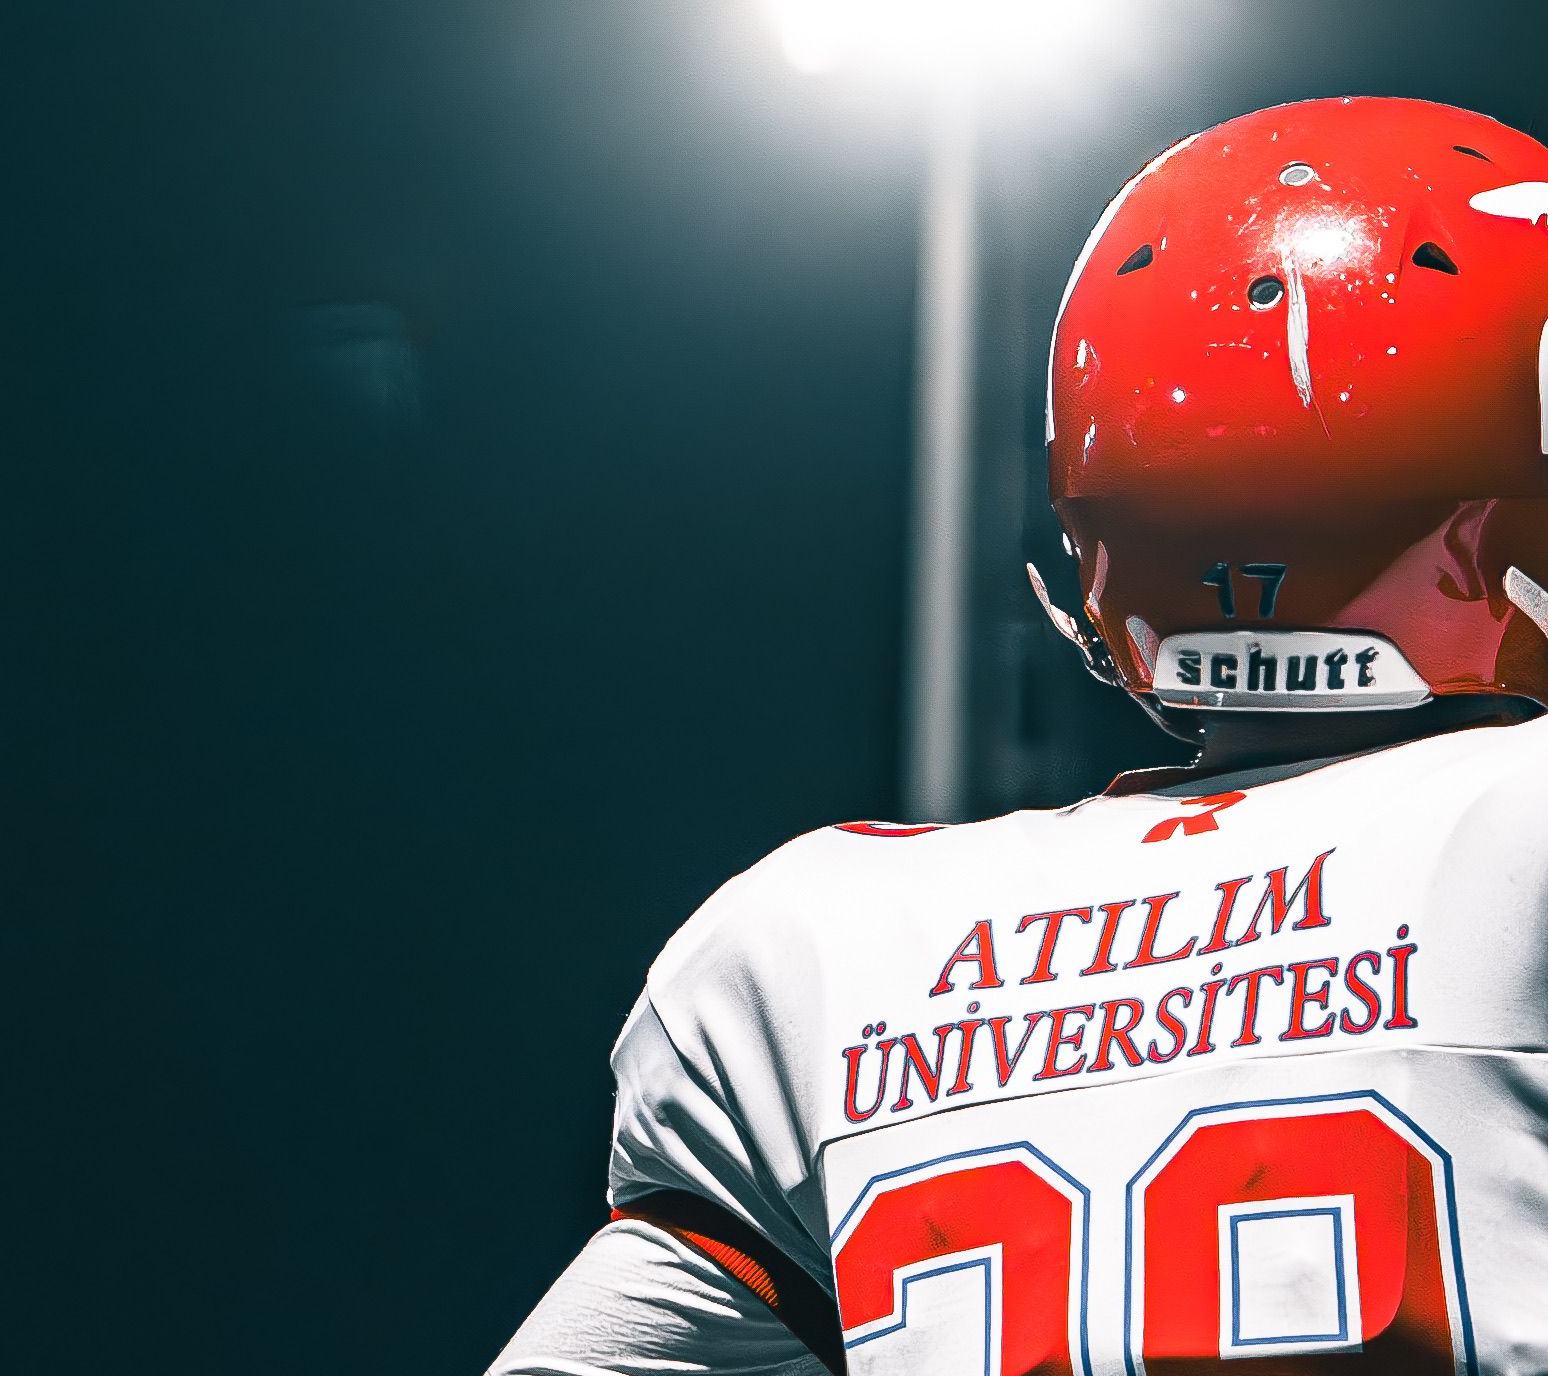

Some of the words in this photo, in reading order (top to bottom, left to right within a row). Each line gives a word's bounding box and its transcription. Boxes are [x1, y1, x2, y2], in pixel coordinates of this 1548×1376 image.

[1203, 561, 1288, 619] 17
[1175, 640, 1380, 692] schutt
[929, 847, 1337, 998] ATILIM
[841, 923, 1419, 1123] ÜNİVERSİTESİ
